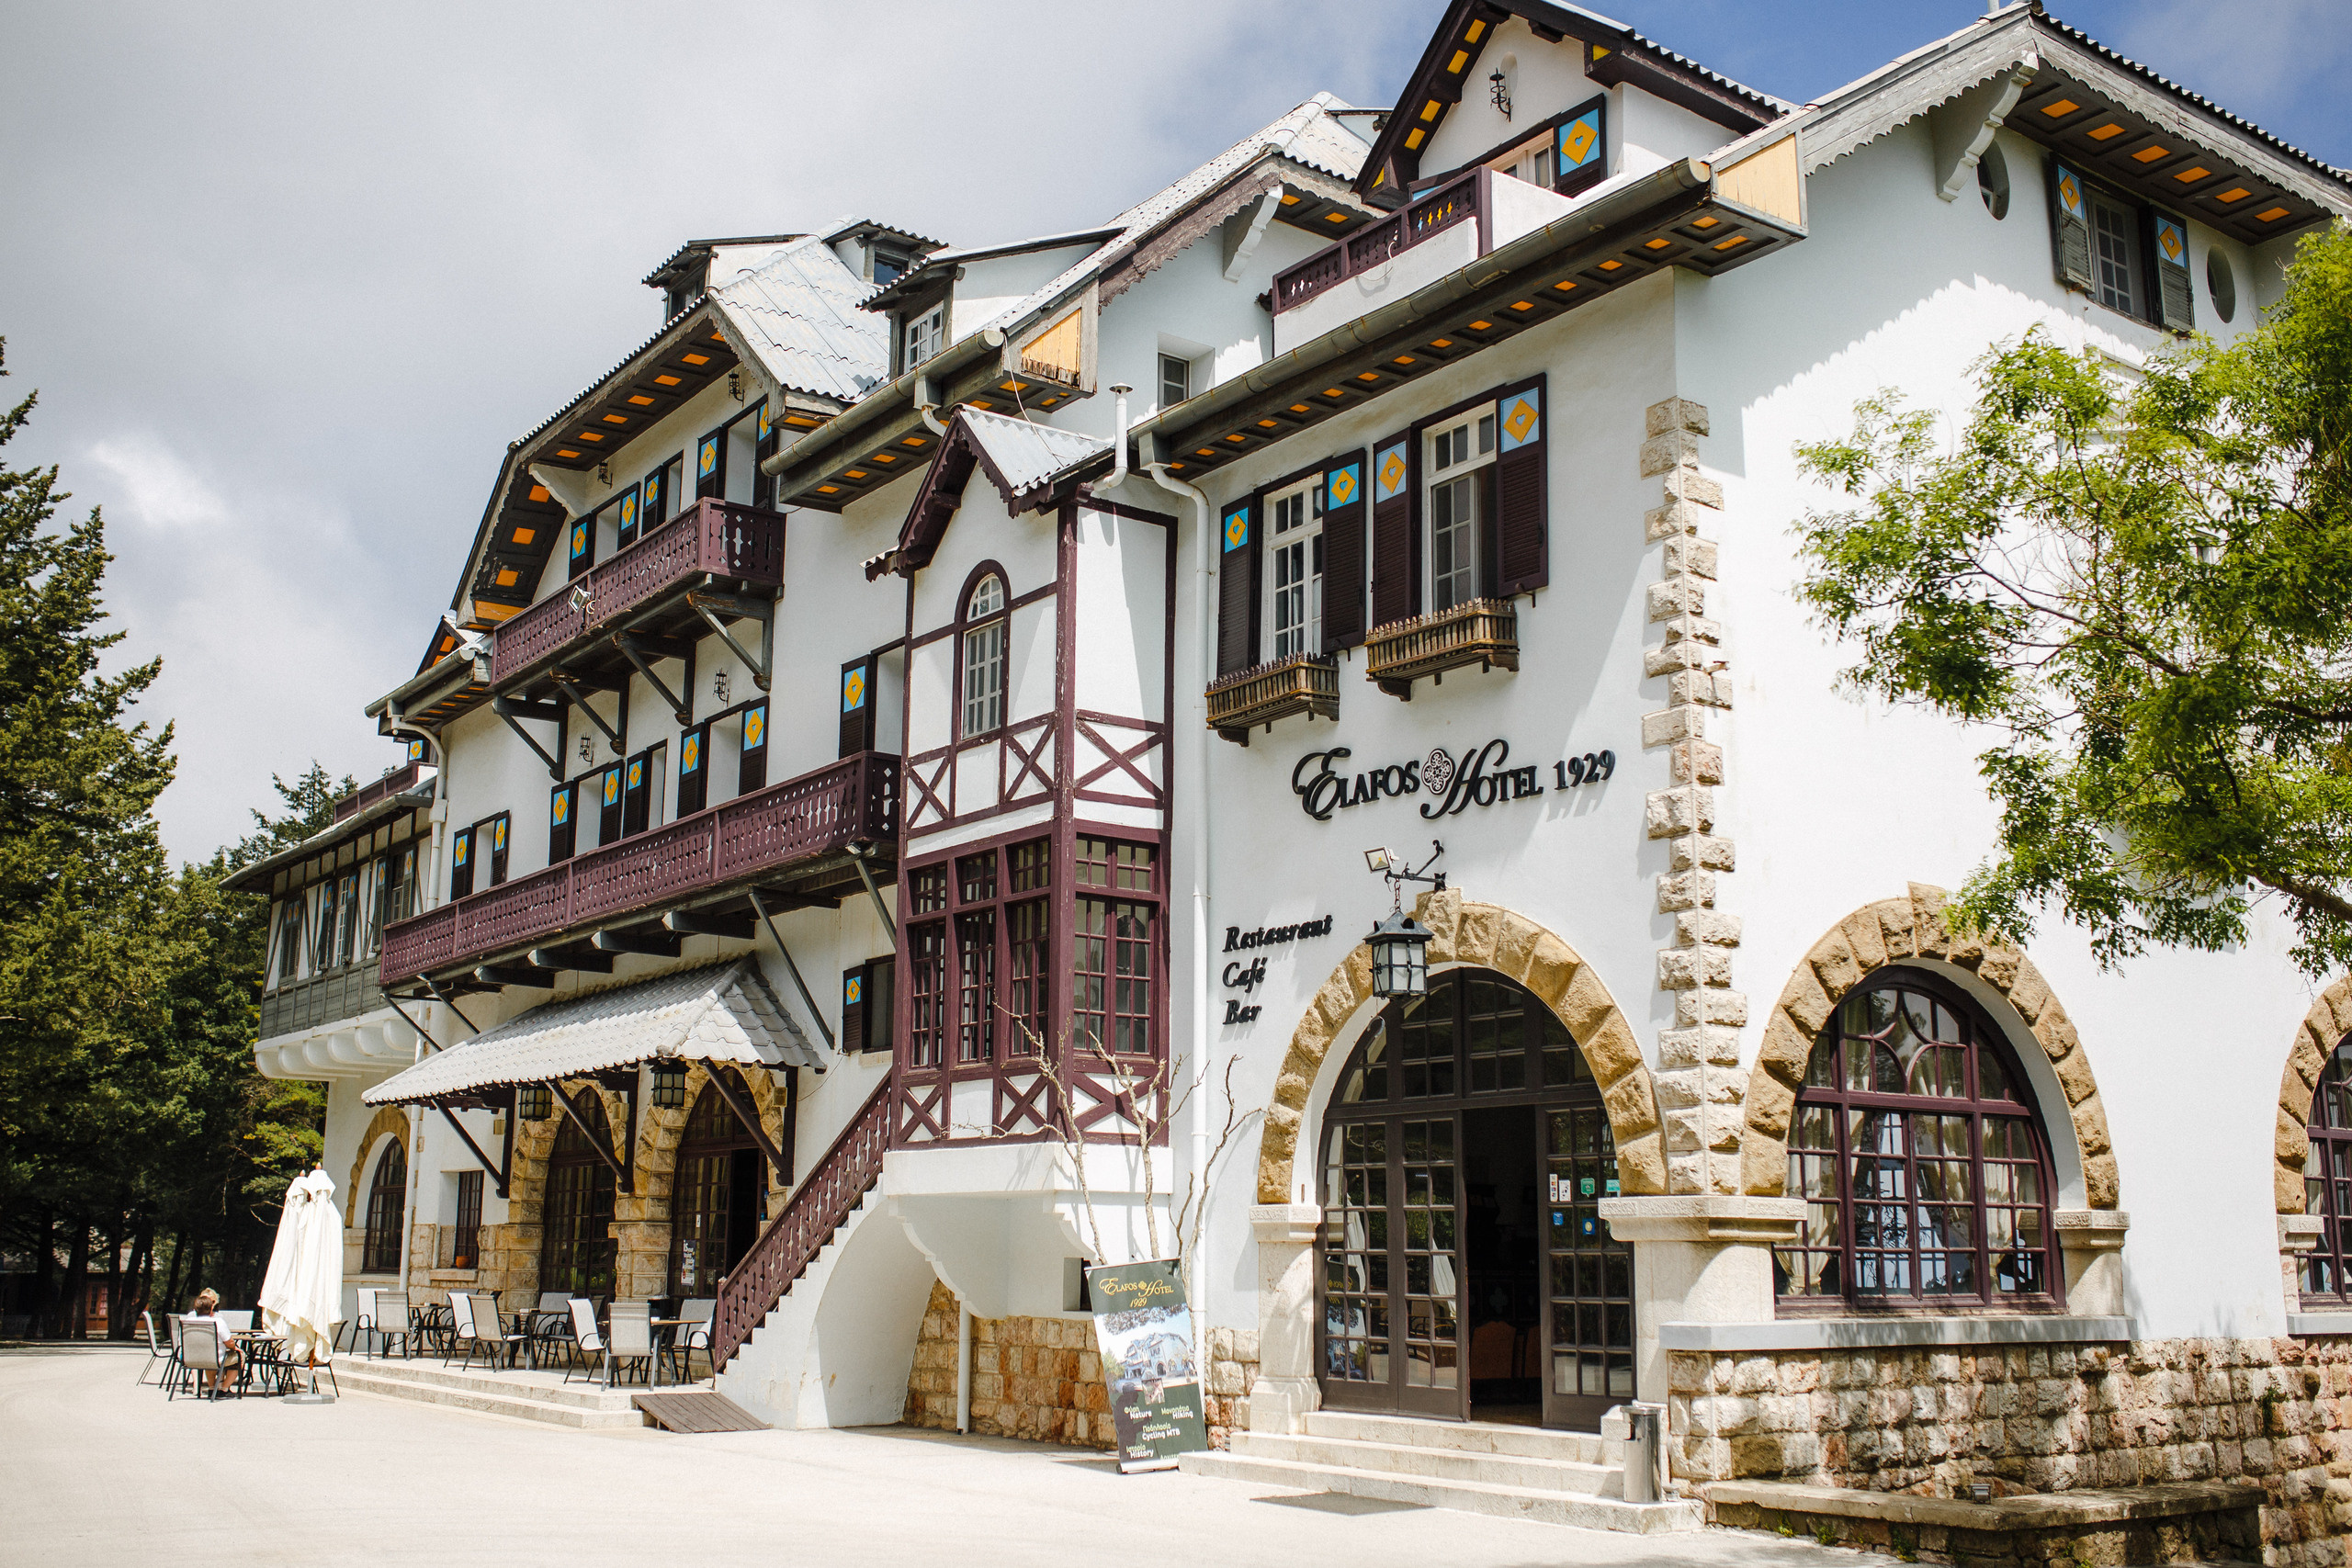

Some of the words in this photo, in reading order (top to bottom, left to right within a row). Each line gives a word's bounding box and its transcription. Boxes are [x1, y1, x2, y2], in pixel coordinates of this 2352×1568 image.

[1292, 747, 1420, 821] ELAFOS
[1419, 739, 1544, 820] HOTEL
[1553, 749, 1616, 791] 1929
[1222, 914, 1333, 953] Restaurant
[1222, 957, 1268, 993] Café
[1223, 999, 1262, 1025] Bar
[1099, 1278, 1137, 1296] ELAFOS
[1138, 1280, 1174, 1297] HOTEL
[1130, 1297, 1148, 1308] 1929
[1129, 1410, 1151, 1419] Nature
[1172, 1410, 1193, 1419] Hiking
[1142, 1431, 1166, 1441] Cycling
[1167, 1428, 1181, 1438] MTB
[1130, 1449, 1154, 1459] History
